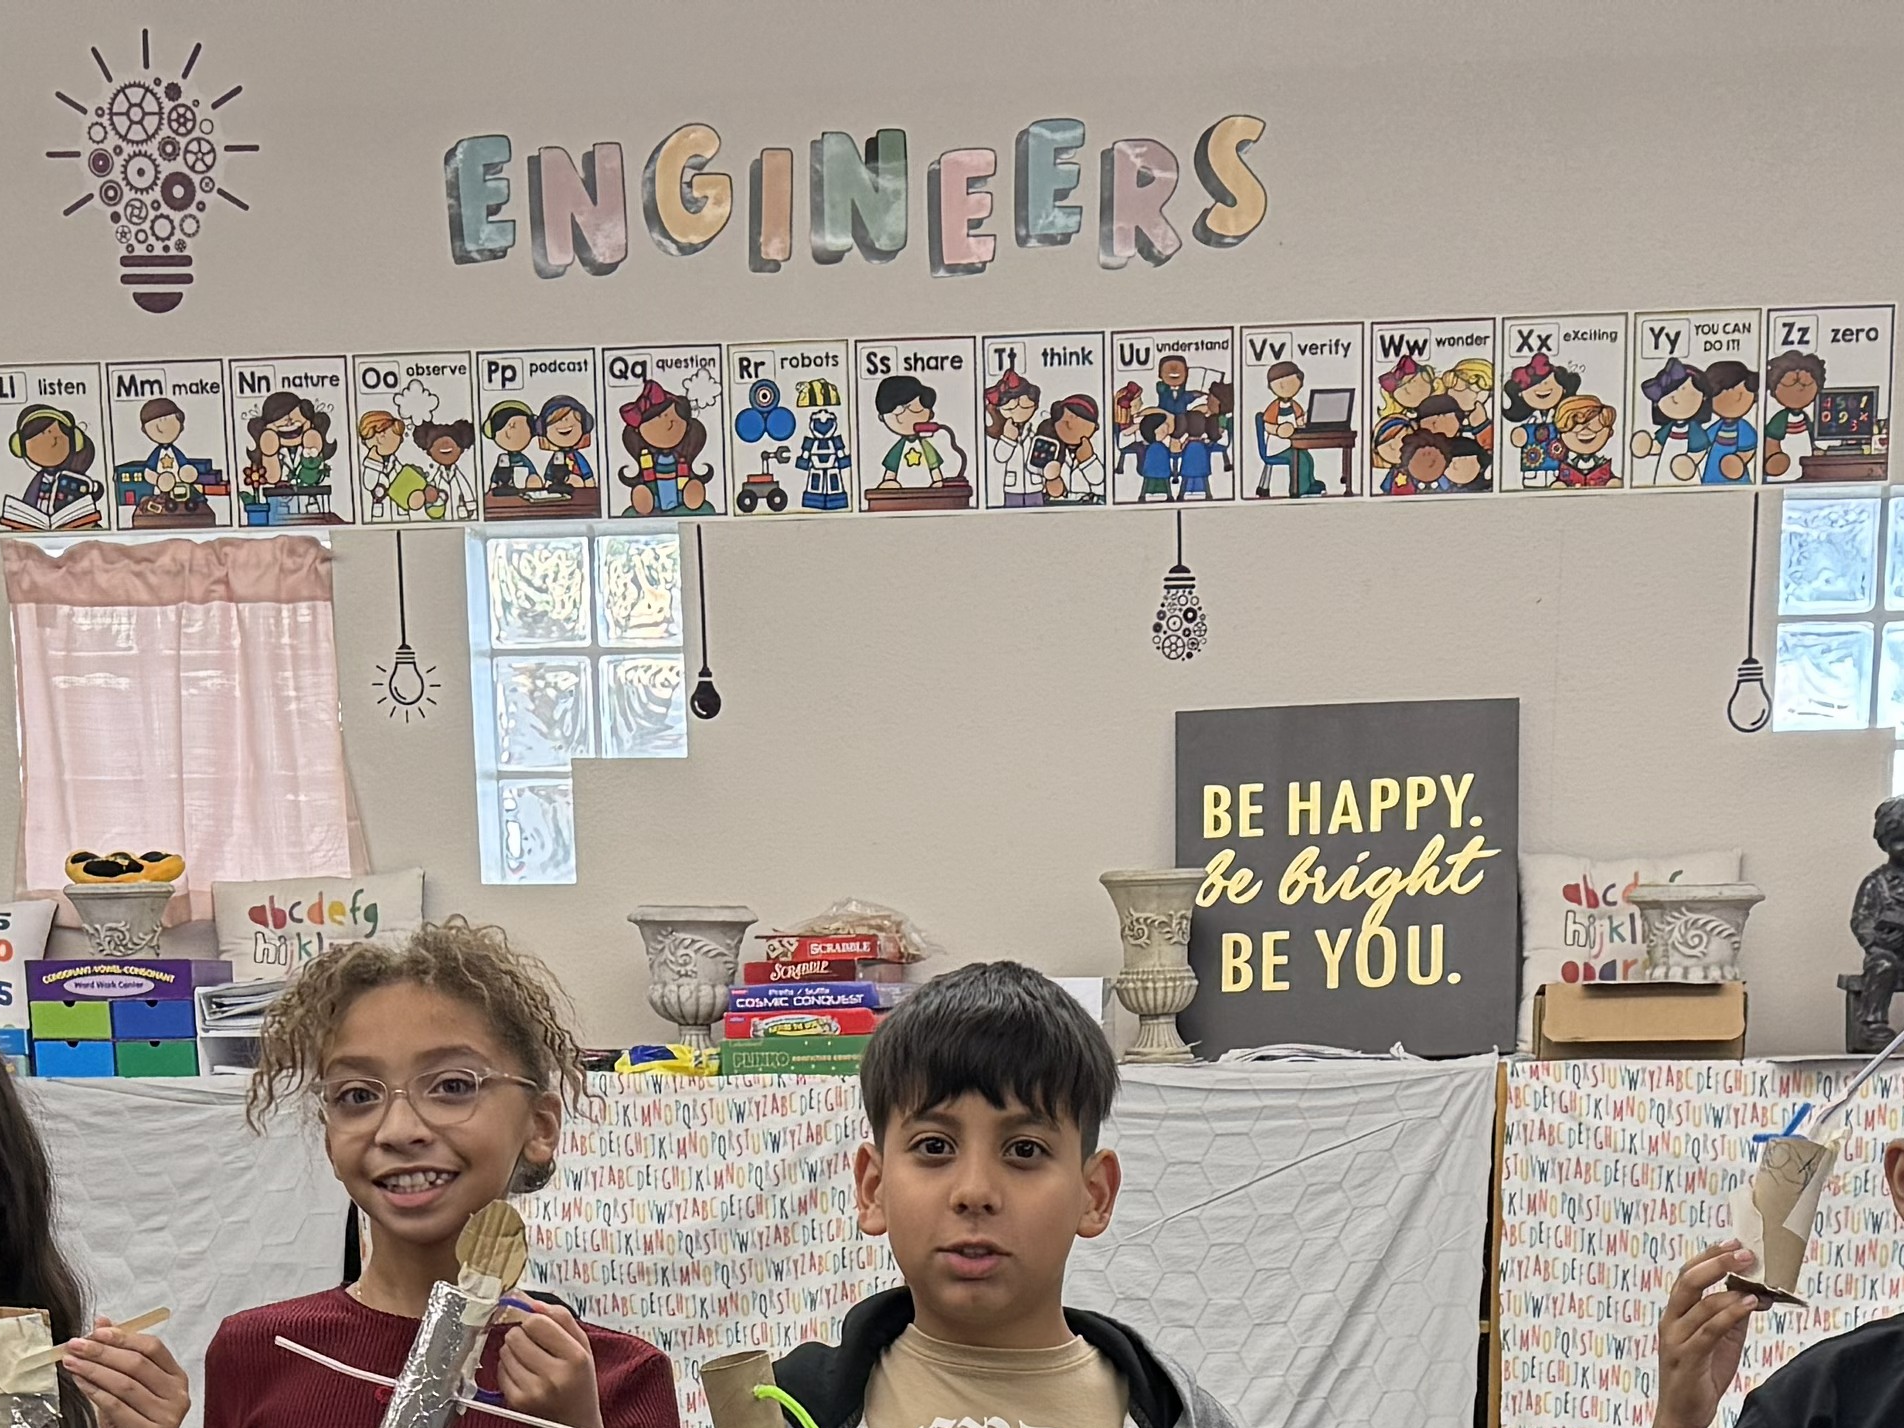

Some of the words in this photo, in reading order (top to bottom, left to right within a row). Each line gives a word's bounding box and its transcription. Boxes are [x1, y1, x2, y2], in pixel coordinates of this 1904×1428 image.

[443, 115, 1266, 279] ENGINEERS
[1380, 334, 1427, 359] Ww
[1435, 333, 1489, 347] wonder
[1516, 328, 1552, 353] Xx
[1562, 329, 1617, 344] eXciting
[1648, 326, 1680, 354] Yy
[1693, 323, 1721, 337] YOU
[1722, 322, 1751, 336] CAN
[1702, 340, 1721, 353] DO
[1780, 322, 1810, 346] Zz
[1829, 326, 1879, 343] zero
[865, 350, 890, 376] Ss
[903, 352, 963, 371] share
[992, 344, 1016, 369] Tt
[1040, 346, 1093, 368] think
[1119, 343, 1149, 365] Uu
[1155, 338, 1228, 354] understand
[1251, 338, 1284, 363] Vv
[1297, 339, 1350, 358] verify
[361, 368, 397, 391] Oo
[406, 362, 466, 378] observe
[486, 361, 516, 388] Pp
[529, 358, 588, 379] podcast
[608, 355, 646, 380] Qq
[654, 355, 715, 372] question
[738, 357, 764, 379] Rr
[780, 351, 839, 368] robots
[38, 379, 86, 397] listen
[116, 374, 163, 397] Mm
[172, 379, 220, 395] make
[238, 371, 271, 394] Nn
[280, 371, 339, 388] nature
[1203, 783, 1264, 838] BE
[1288, 773, 1482, 836] HAPPY.
[1195, 847, 1263, 908] be
[1278, 833, 1502, 933] bright
[810, 941, 871, 954] SCRABBLE
[1221, 930, 1290, 993] BE
[1314, 924, 1462, 988] YOU.
[736, 996, 789, 1008] COSMIC
[793, 993, 864, 1007] CONQUEST
